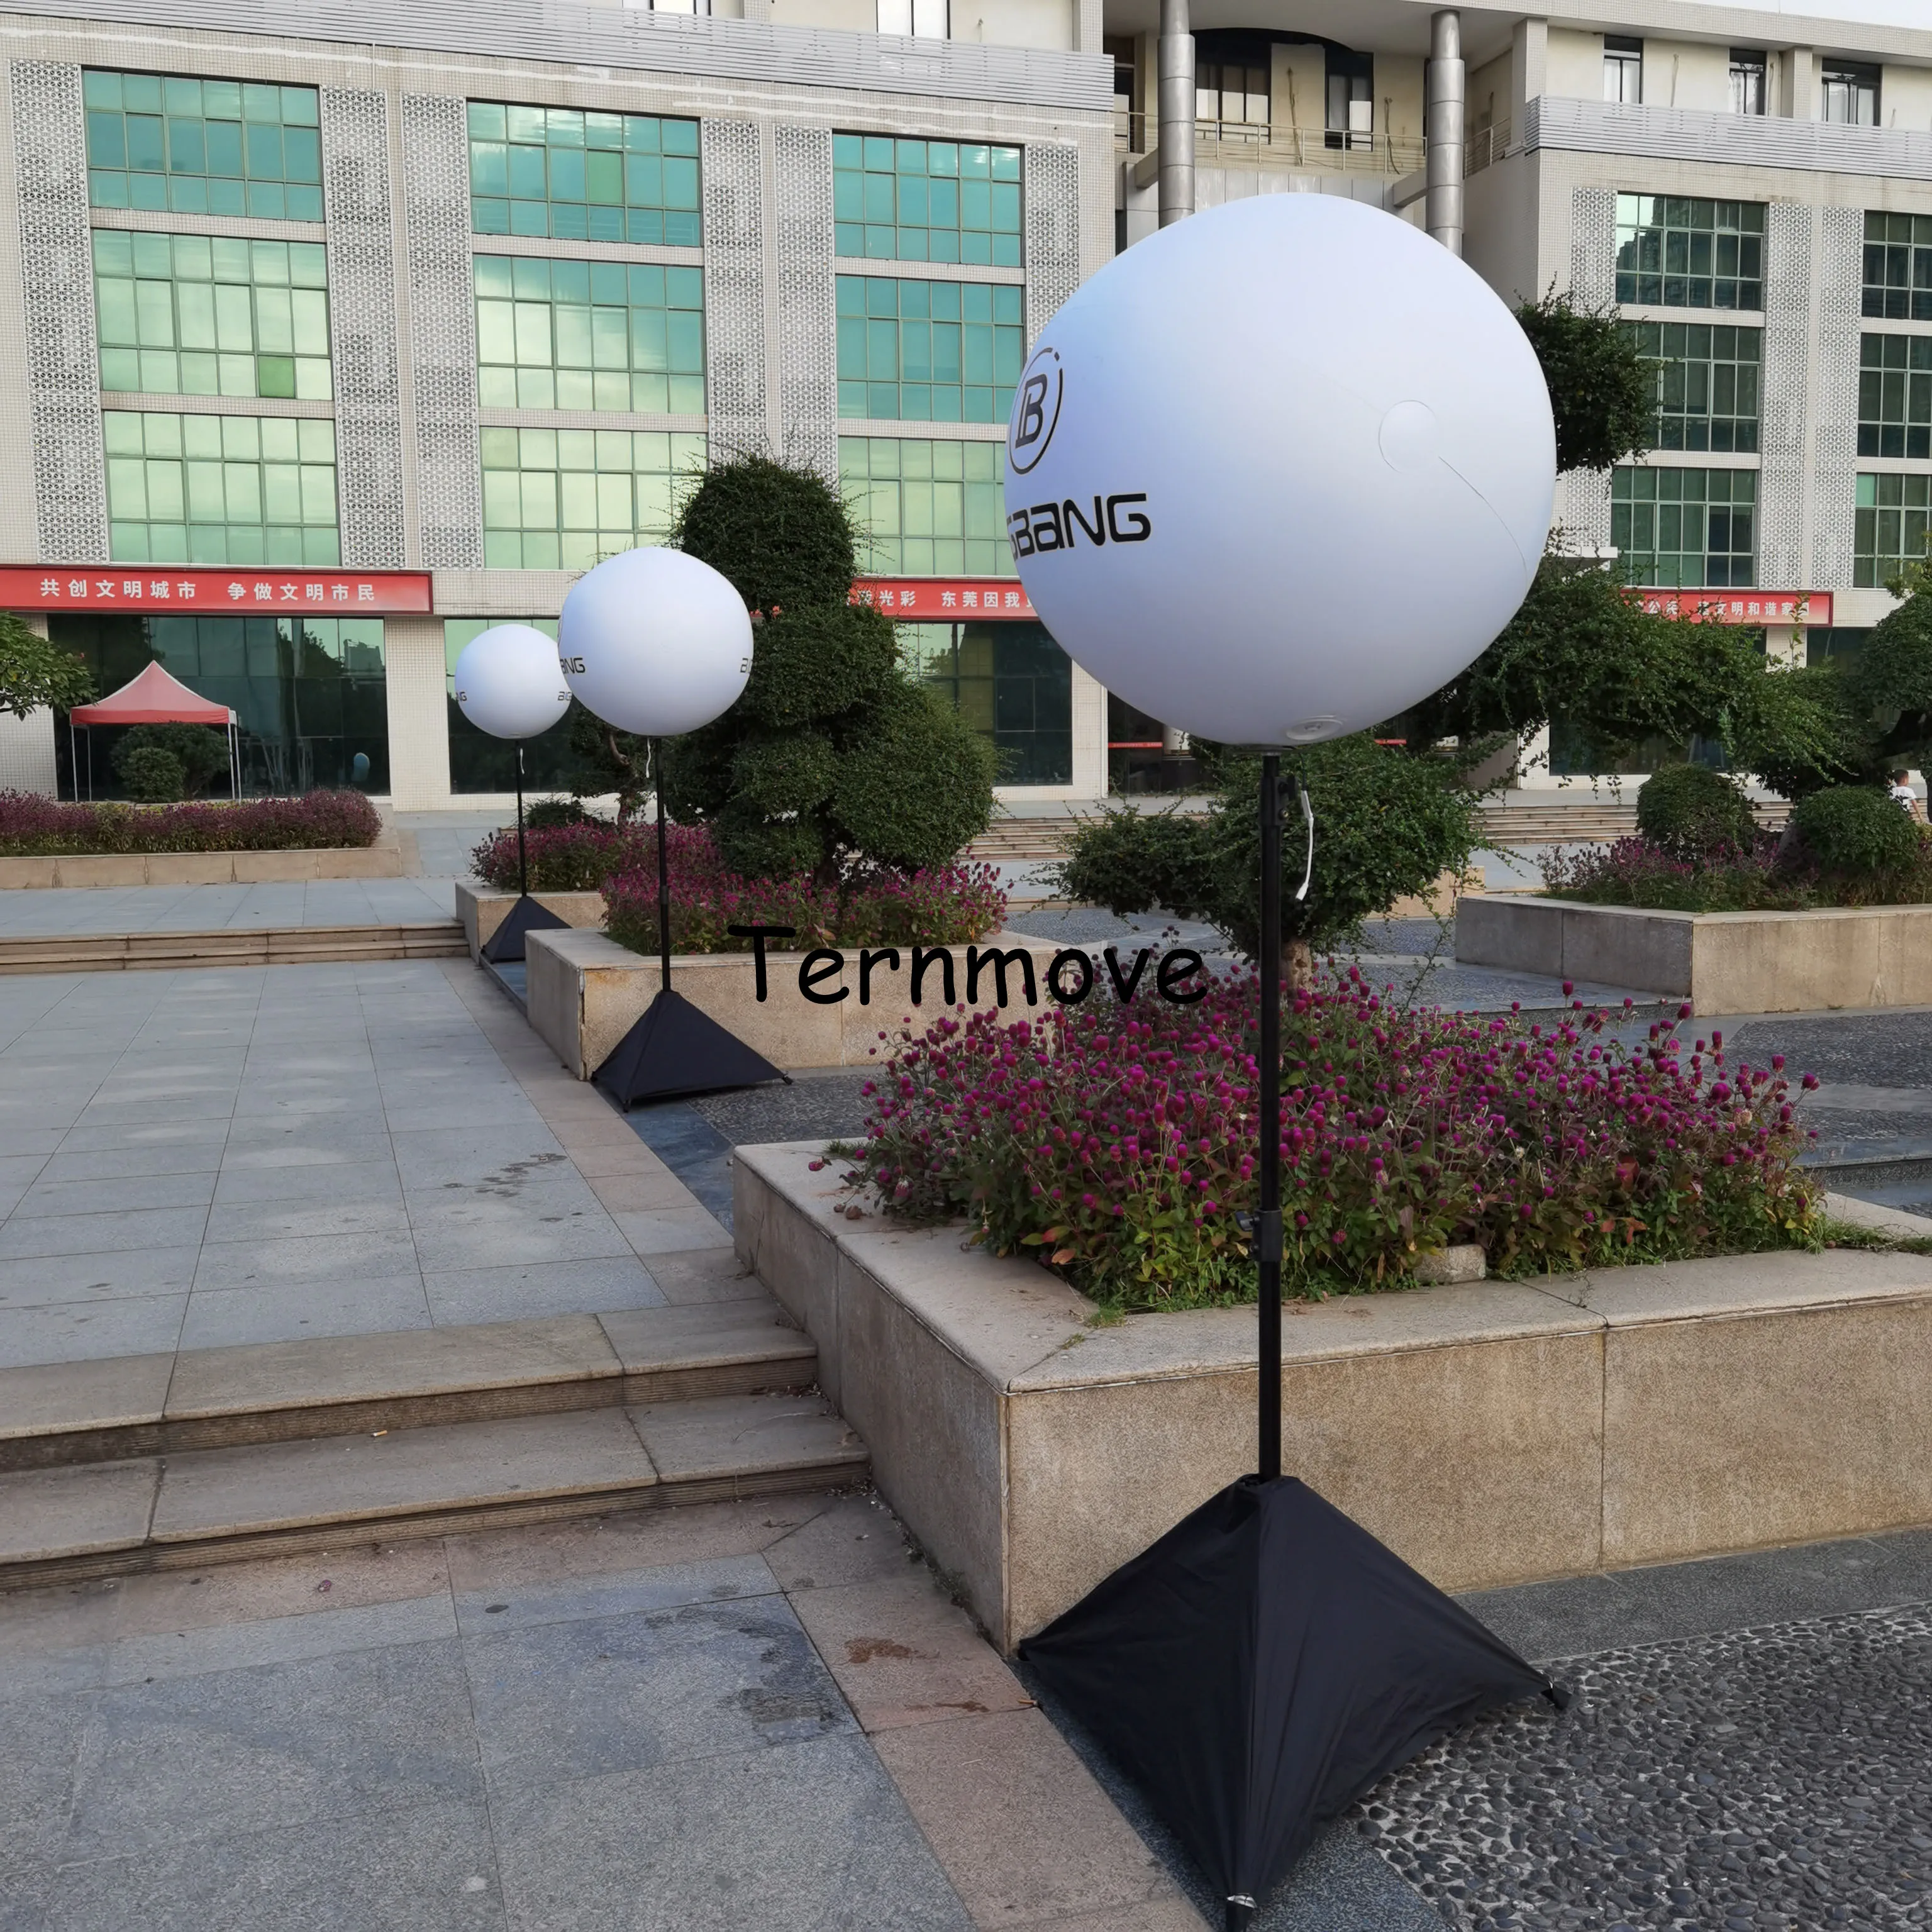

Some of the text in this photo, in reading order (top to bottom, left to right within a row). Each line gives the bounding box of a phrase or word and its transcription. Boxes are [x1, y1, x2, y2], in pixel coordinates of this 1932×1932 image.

[40, 578, 375, 601] 共创文明城市 争做文明市民
[941, 591, 1033, 608] 东莞因我
